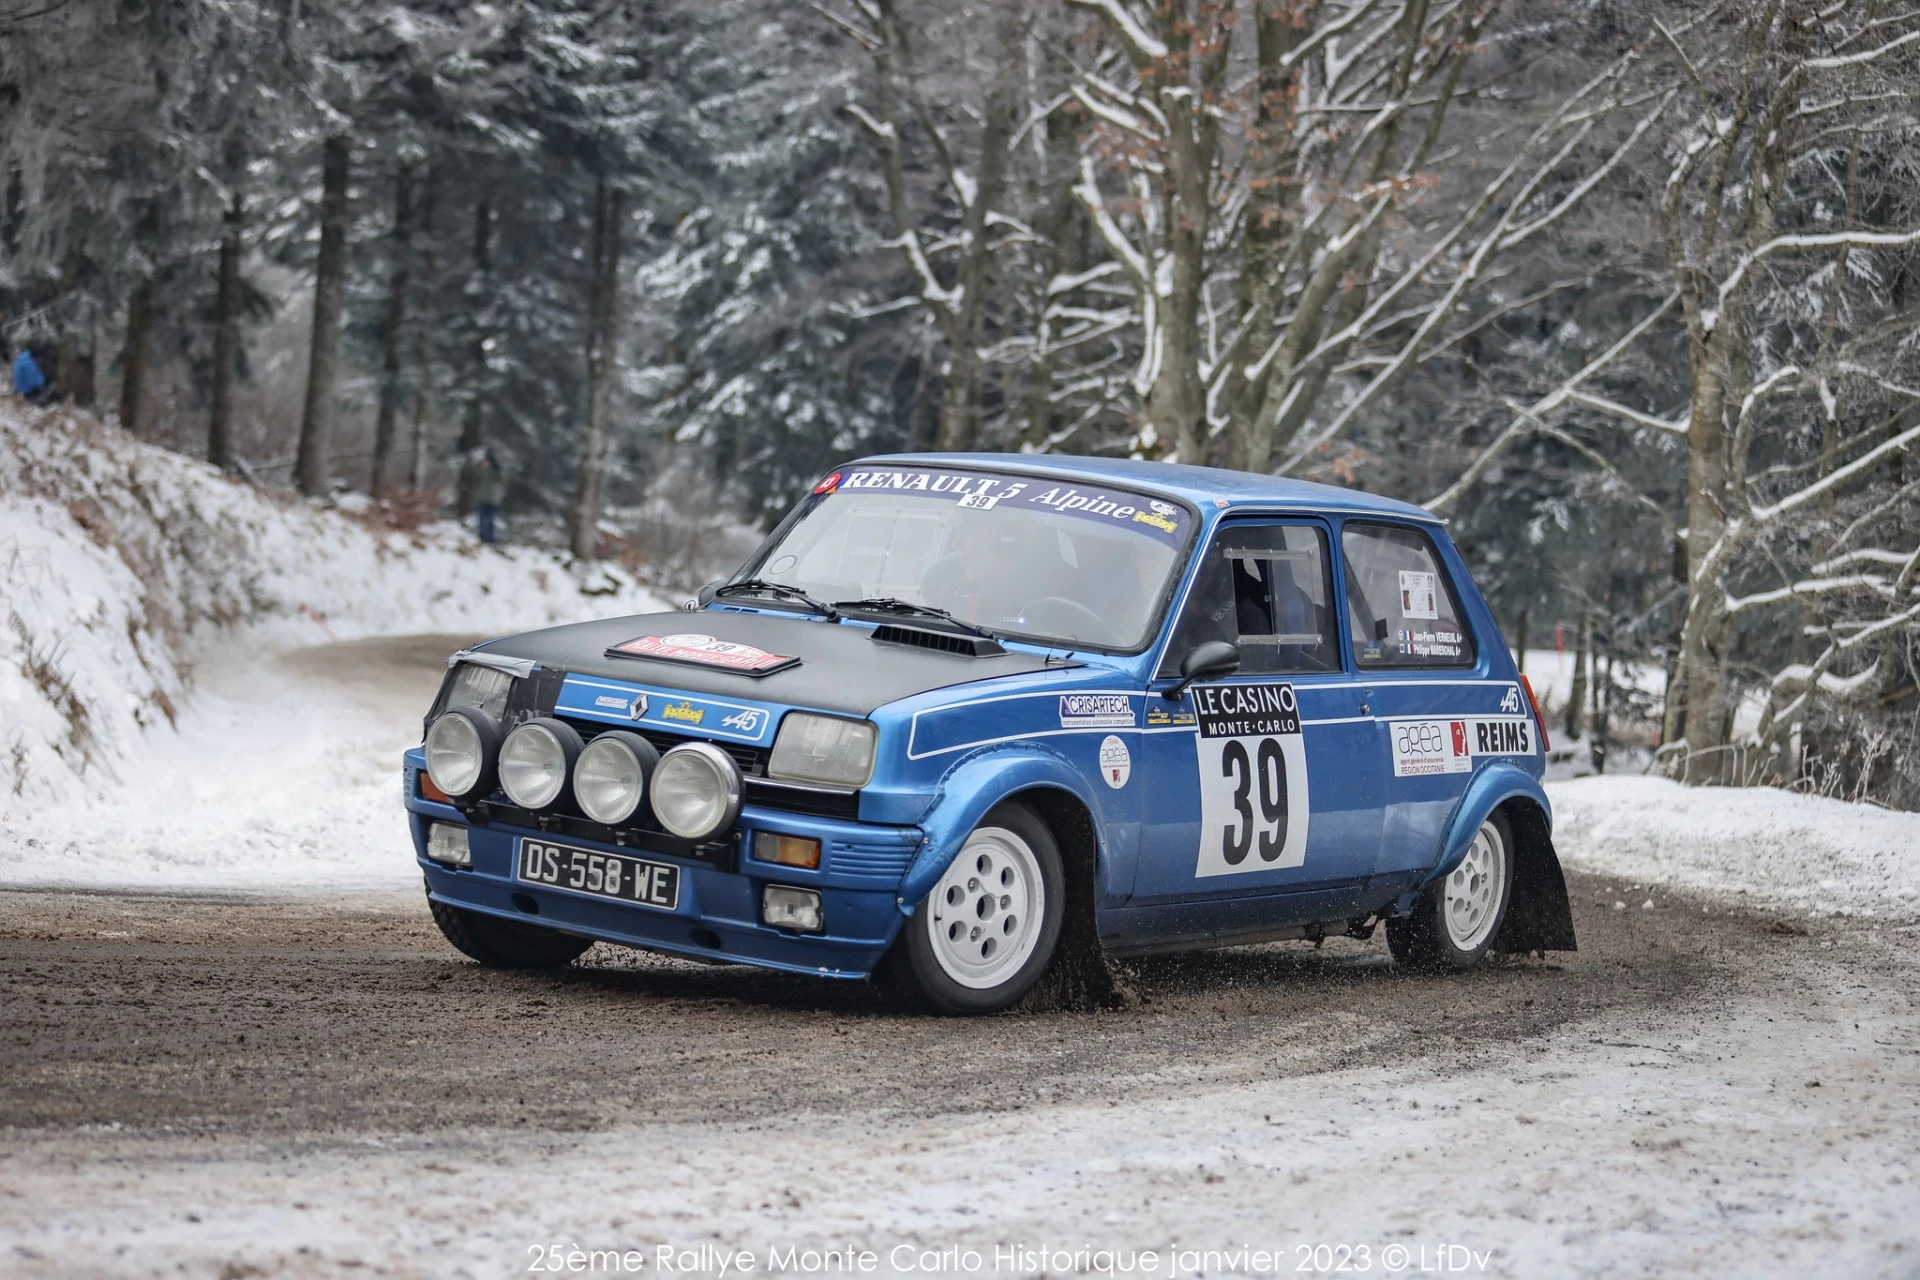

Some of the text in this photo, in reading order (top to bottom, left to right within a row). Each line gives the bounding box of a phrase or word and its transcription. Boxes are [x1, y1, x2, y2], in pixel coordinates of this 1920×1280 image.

[840, 471, 1001, 496] RENAULT
[998, 482, 1028, 500] 5
[1029, 487, 1135, 519] Alpine
[966, 494, 990, 508] 39
[706, 643, 737, 652] 39
[1195, 686, 1295, 715] LE CASINO
[1476, 722, 1529, 752] REIMS
[1222, 738, 1289, 866] 39
